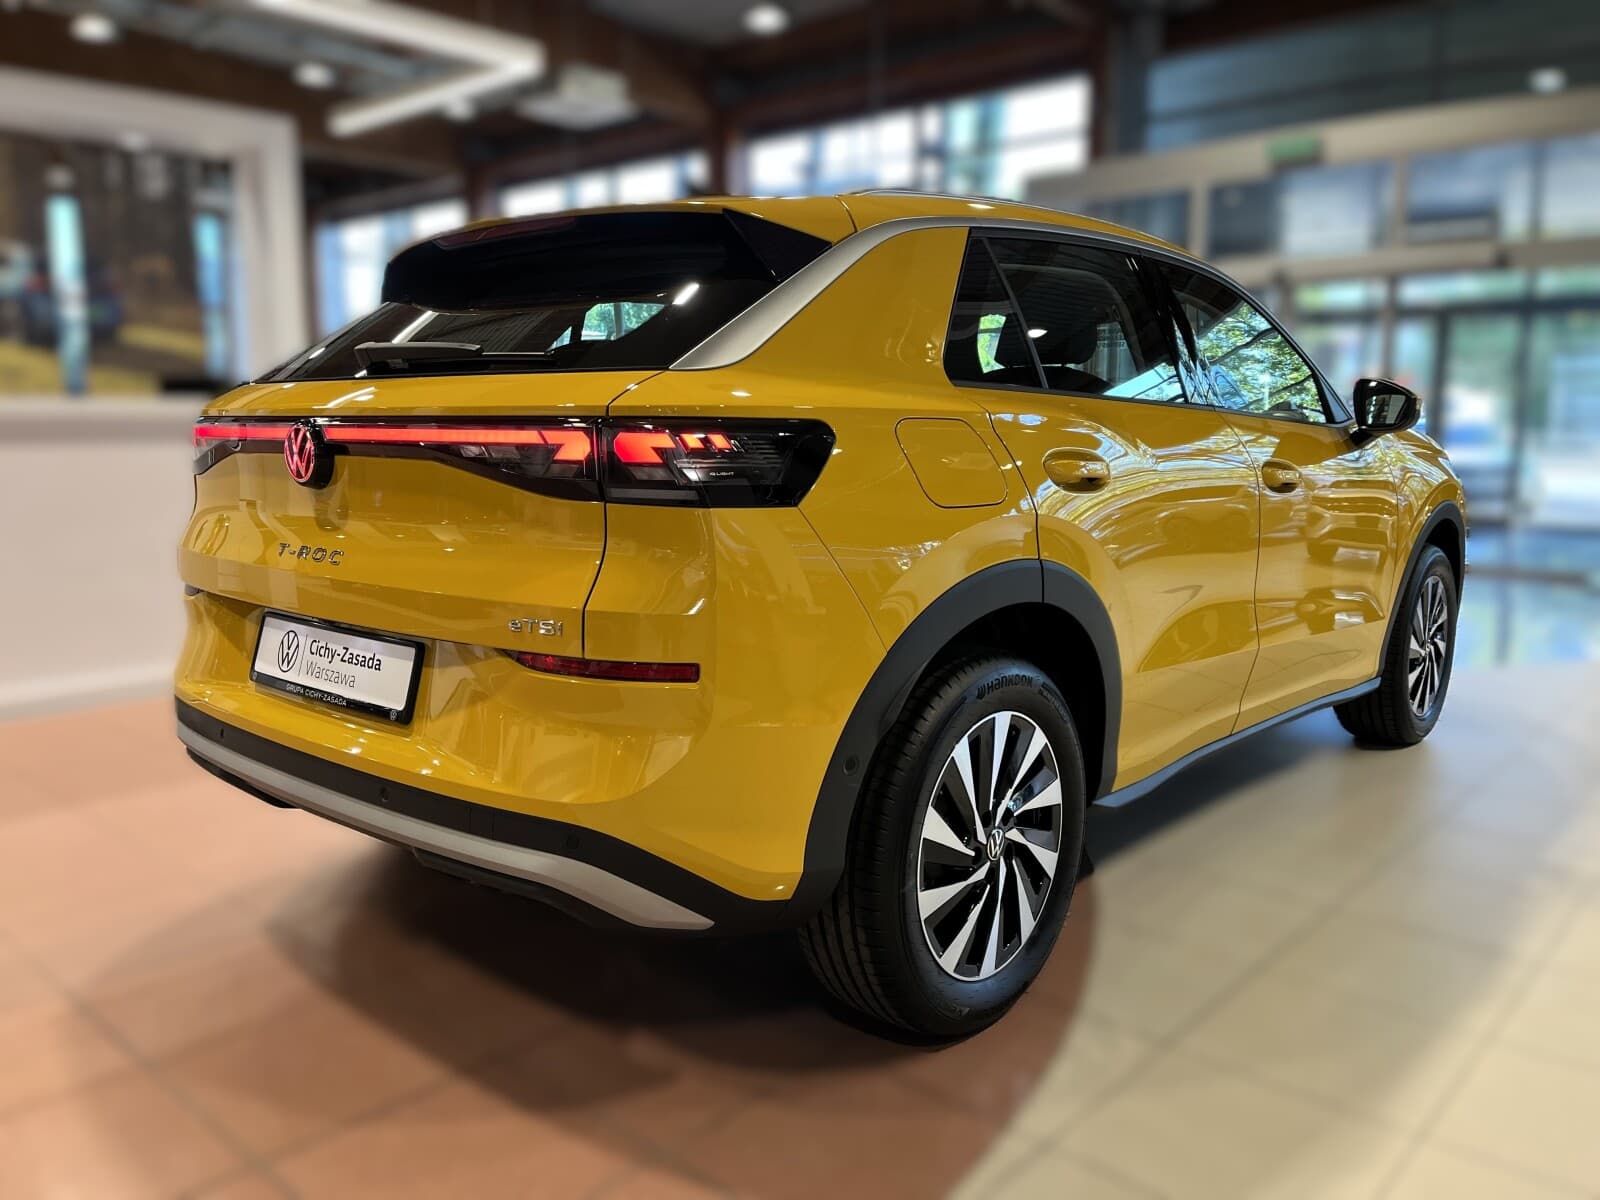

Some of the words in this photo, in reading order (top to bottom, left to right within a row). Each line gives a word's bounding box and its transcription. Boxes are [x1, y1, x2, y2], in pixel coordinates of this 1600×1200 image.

[278, 542, 345, 566] T-ROC
[309, 639, 382, 672] Cichy-Zasada
[305, 659, 356, 688] Warszawa
[286, 683, 304, 696] GRUPA
[304, 689, 347, 707] CICHY-ZASADA
